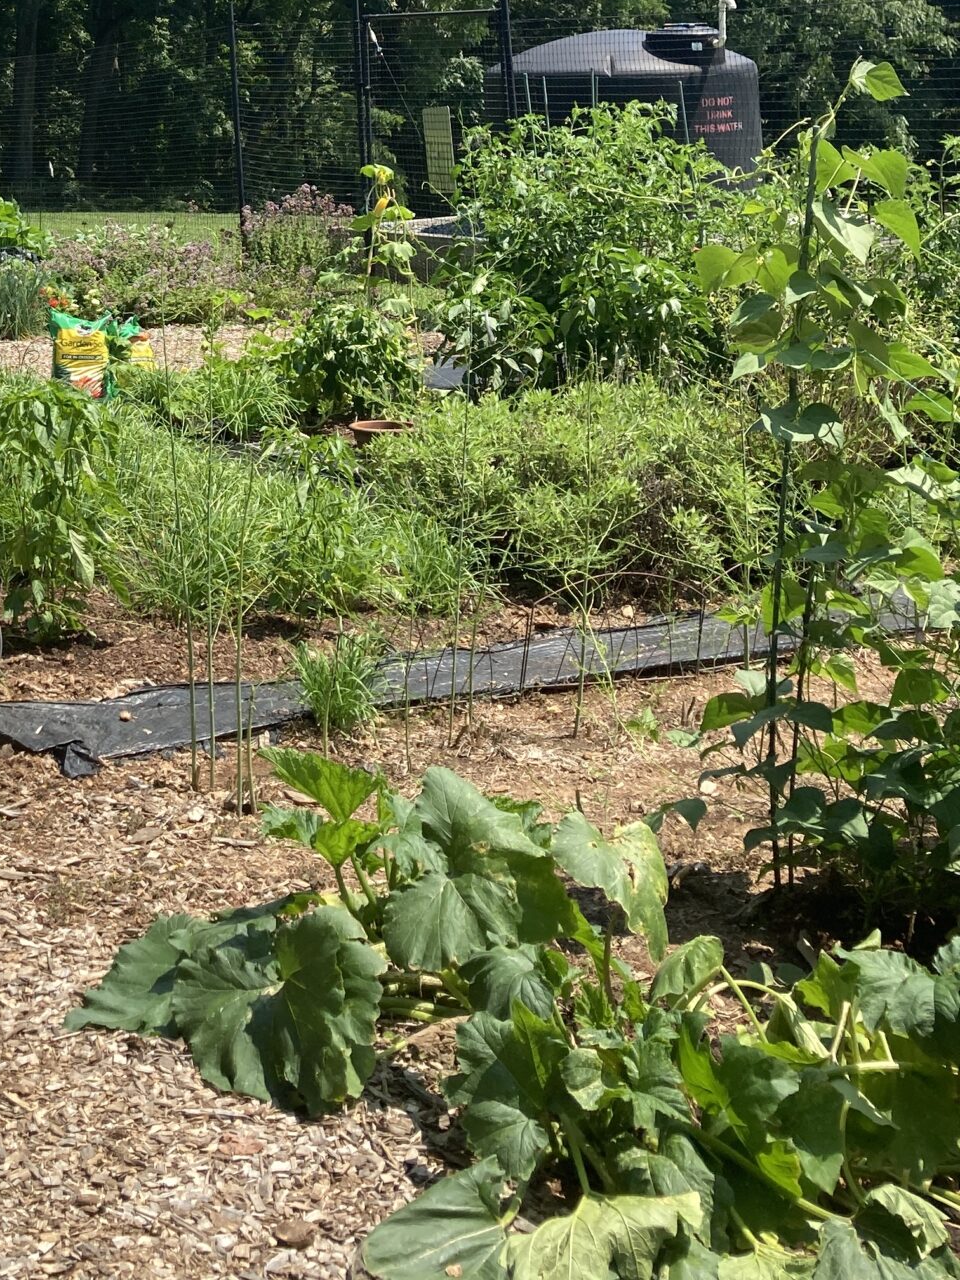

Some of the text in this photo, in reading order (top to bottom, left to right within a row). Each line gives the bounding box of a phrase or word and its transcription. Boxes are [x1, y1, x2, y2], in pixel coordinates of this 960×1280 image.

[701, 96, 733, 107] DO NOT
[706, 110, 733, 120] DRINK
[694, 122, 743, 133] THIS WATER
[61, 338, 92, 348] Garden
